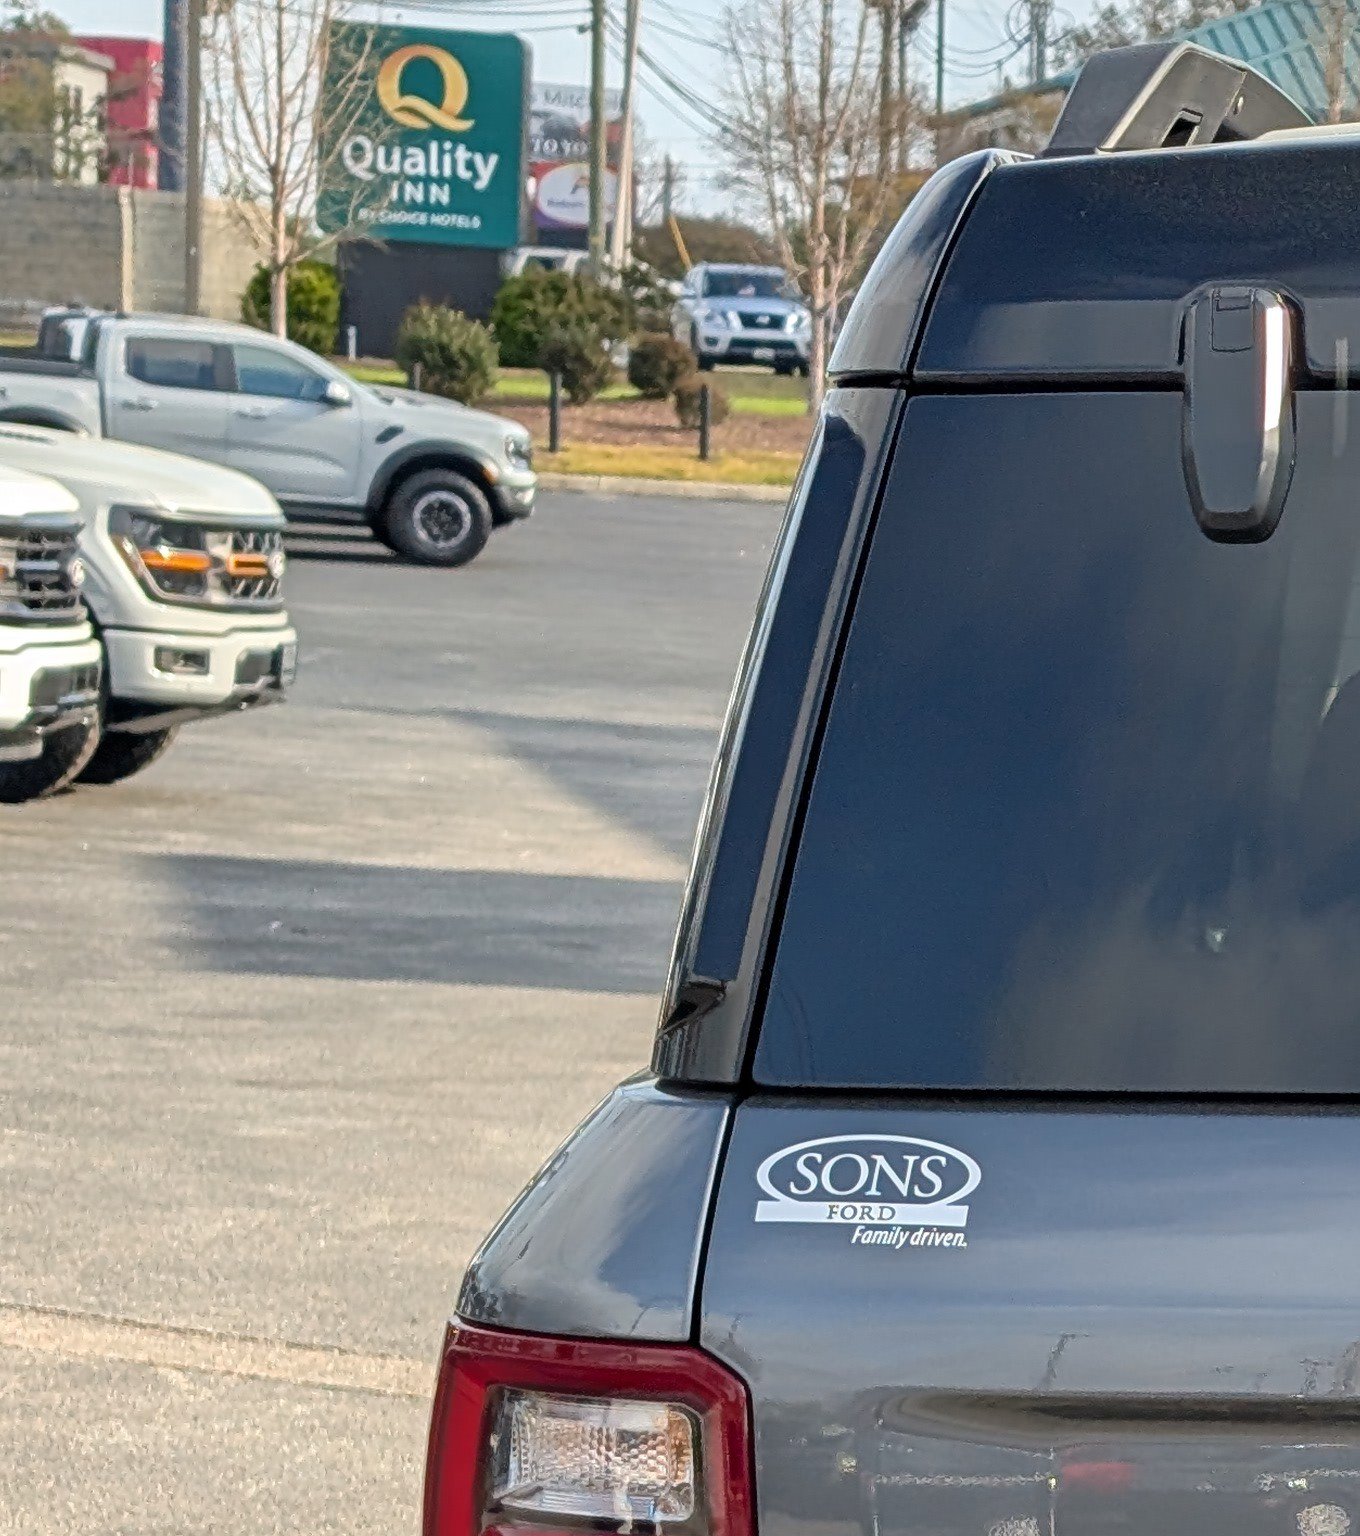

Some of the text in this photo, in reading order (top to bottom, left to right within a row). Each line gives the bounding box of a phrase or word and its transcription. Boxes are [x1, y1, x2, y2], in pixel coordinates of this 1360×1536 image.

[343, 134, 499, 191] Quality
[390, 179, 450, 206] INN
[430, 212, 482, 230] HOTELS
[790, 1152, 947, 1198] SONS
[826, 1204, 896, 1222] FORD
[851, 1225, 967, 1250] Family driven.
